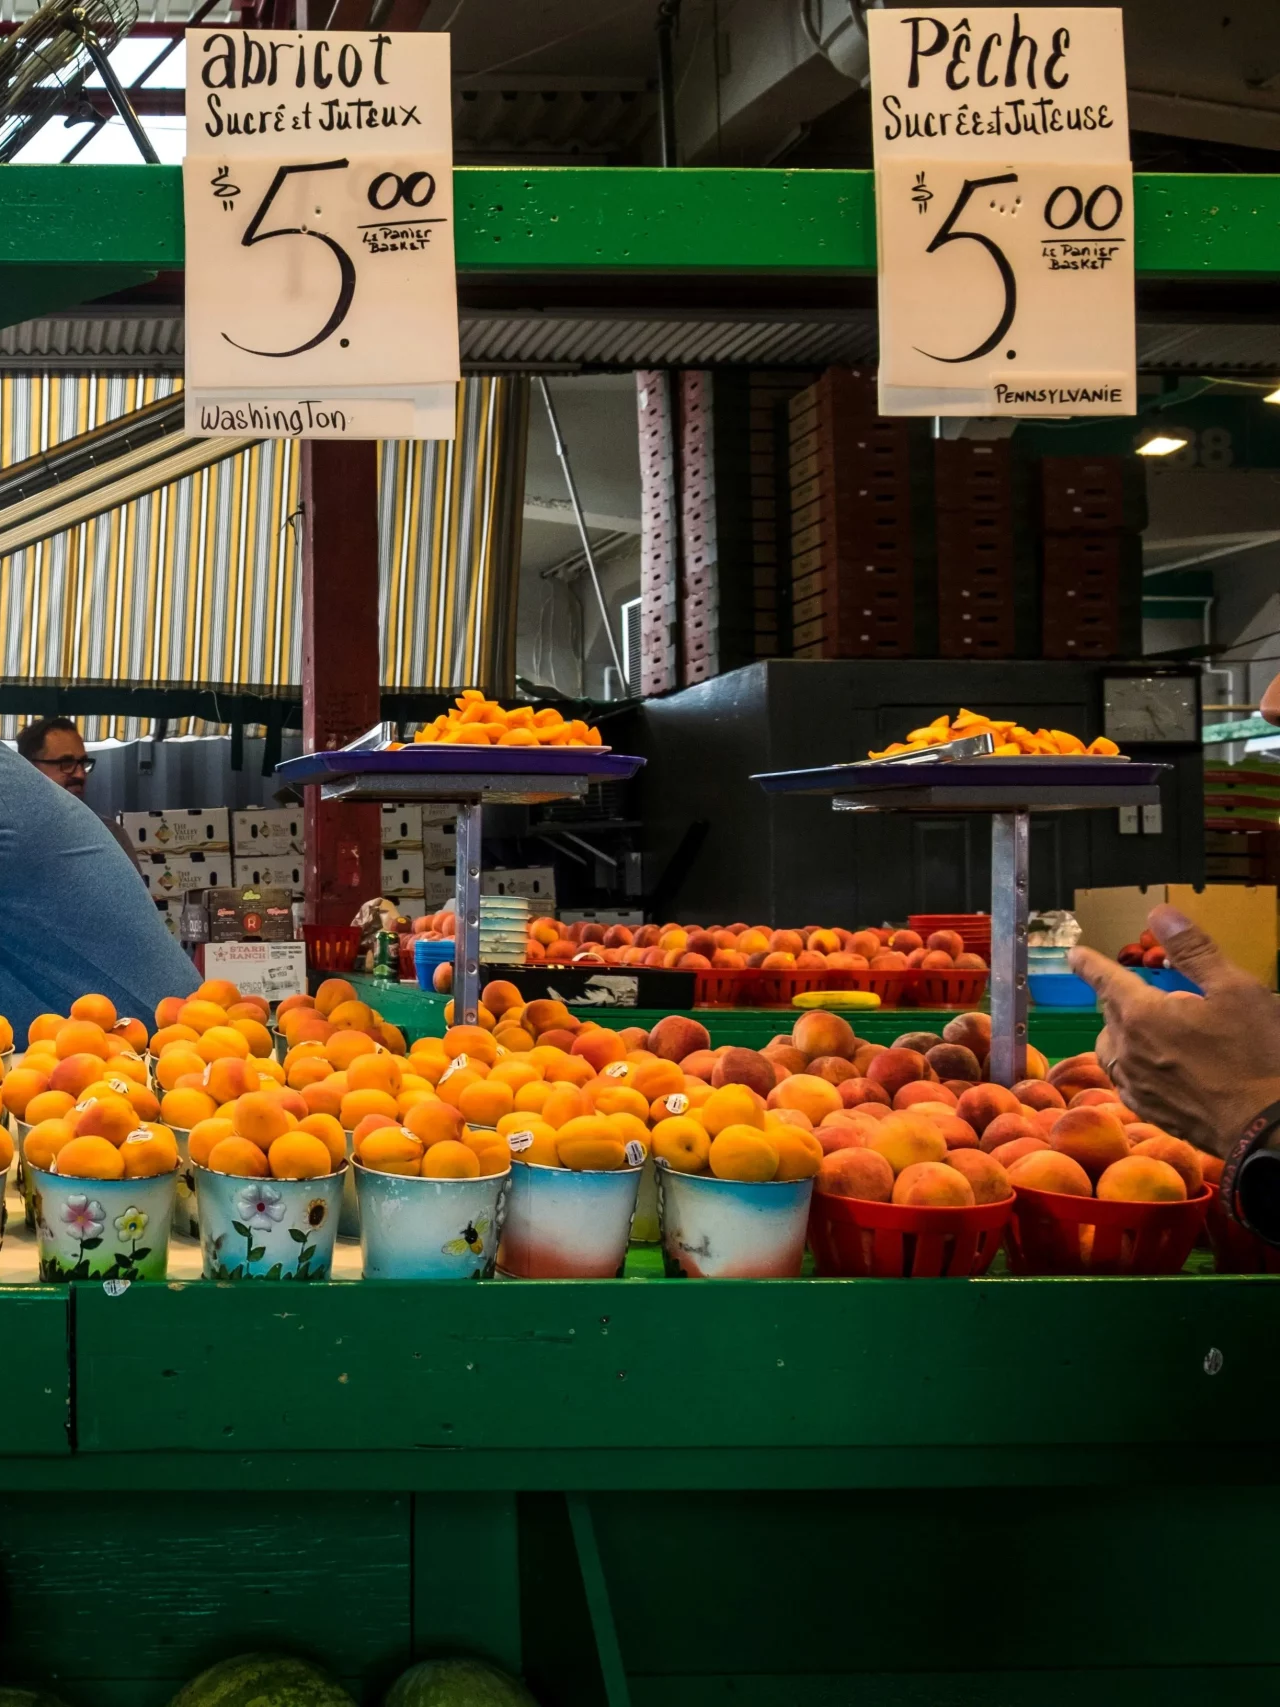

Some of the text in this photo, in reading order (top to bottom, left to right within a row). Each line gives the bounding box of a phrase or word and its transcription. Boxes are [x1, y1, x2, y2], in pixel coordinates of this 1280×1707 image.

[900, 13, 1071, 91] Pêche
[205, 93, 422, 138] Sucré et Juteux
[882, 95, 1114, 141] Sucrée et Juteuse
[369, 239, 431, 254] Basket
[382, 227, 433, 240] Panier
[1062, 243, 1119, 258] Panier
[1048, 257, 1113, 271] Basket
[200, 399, 348, 436] Washington
